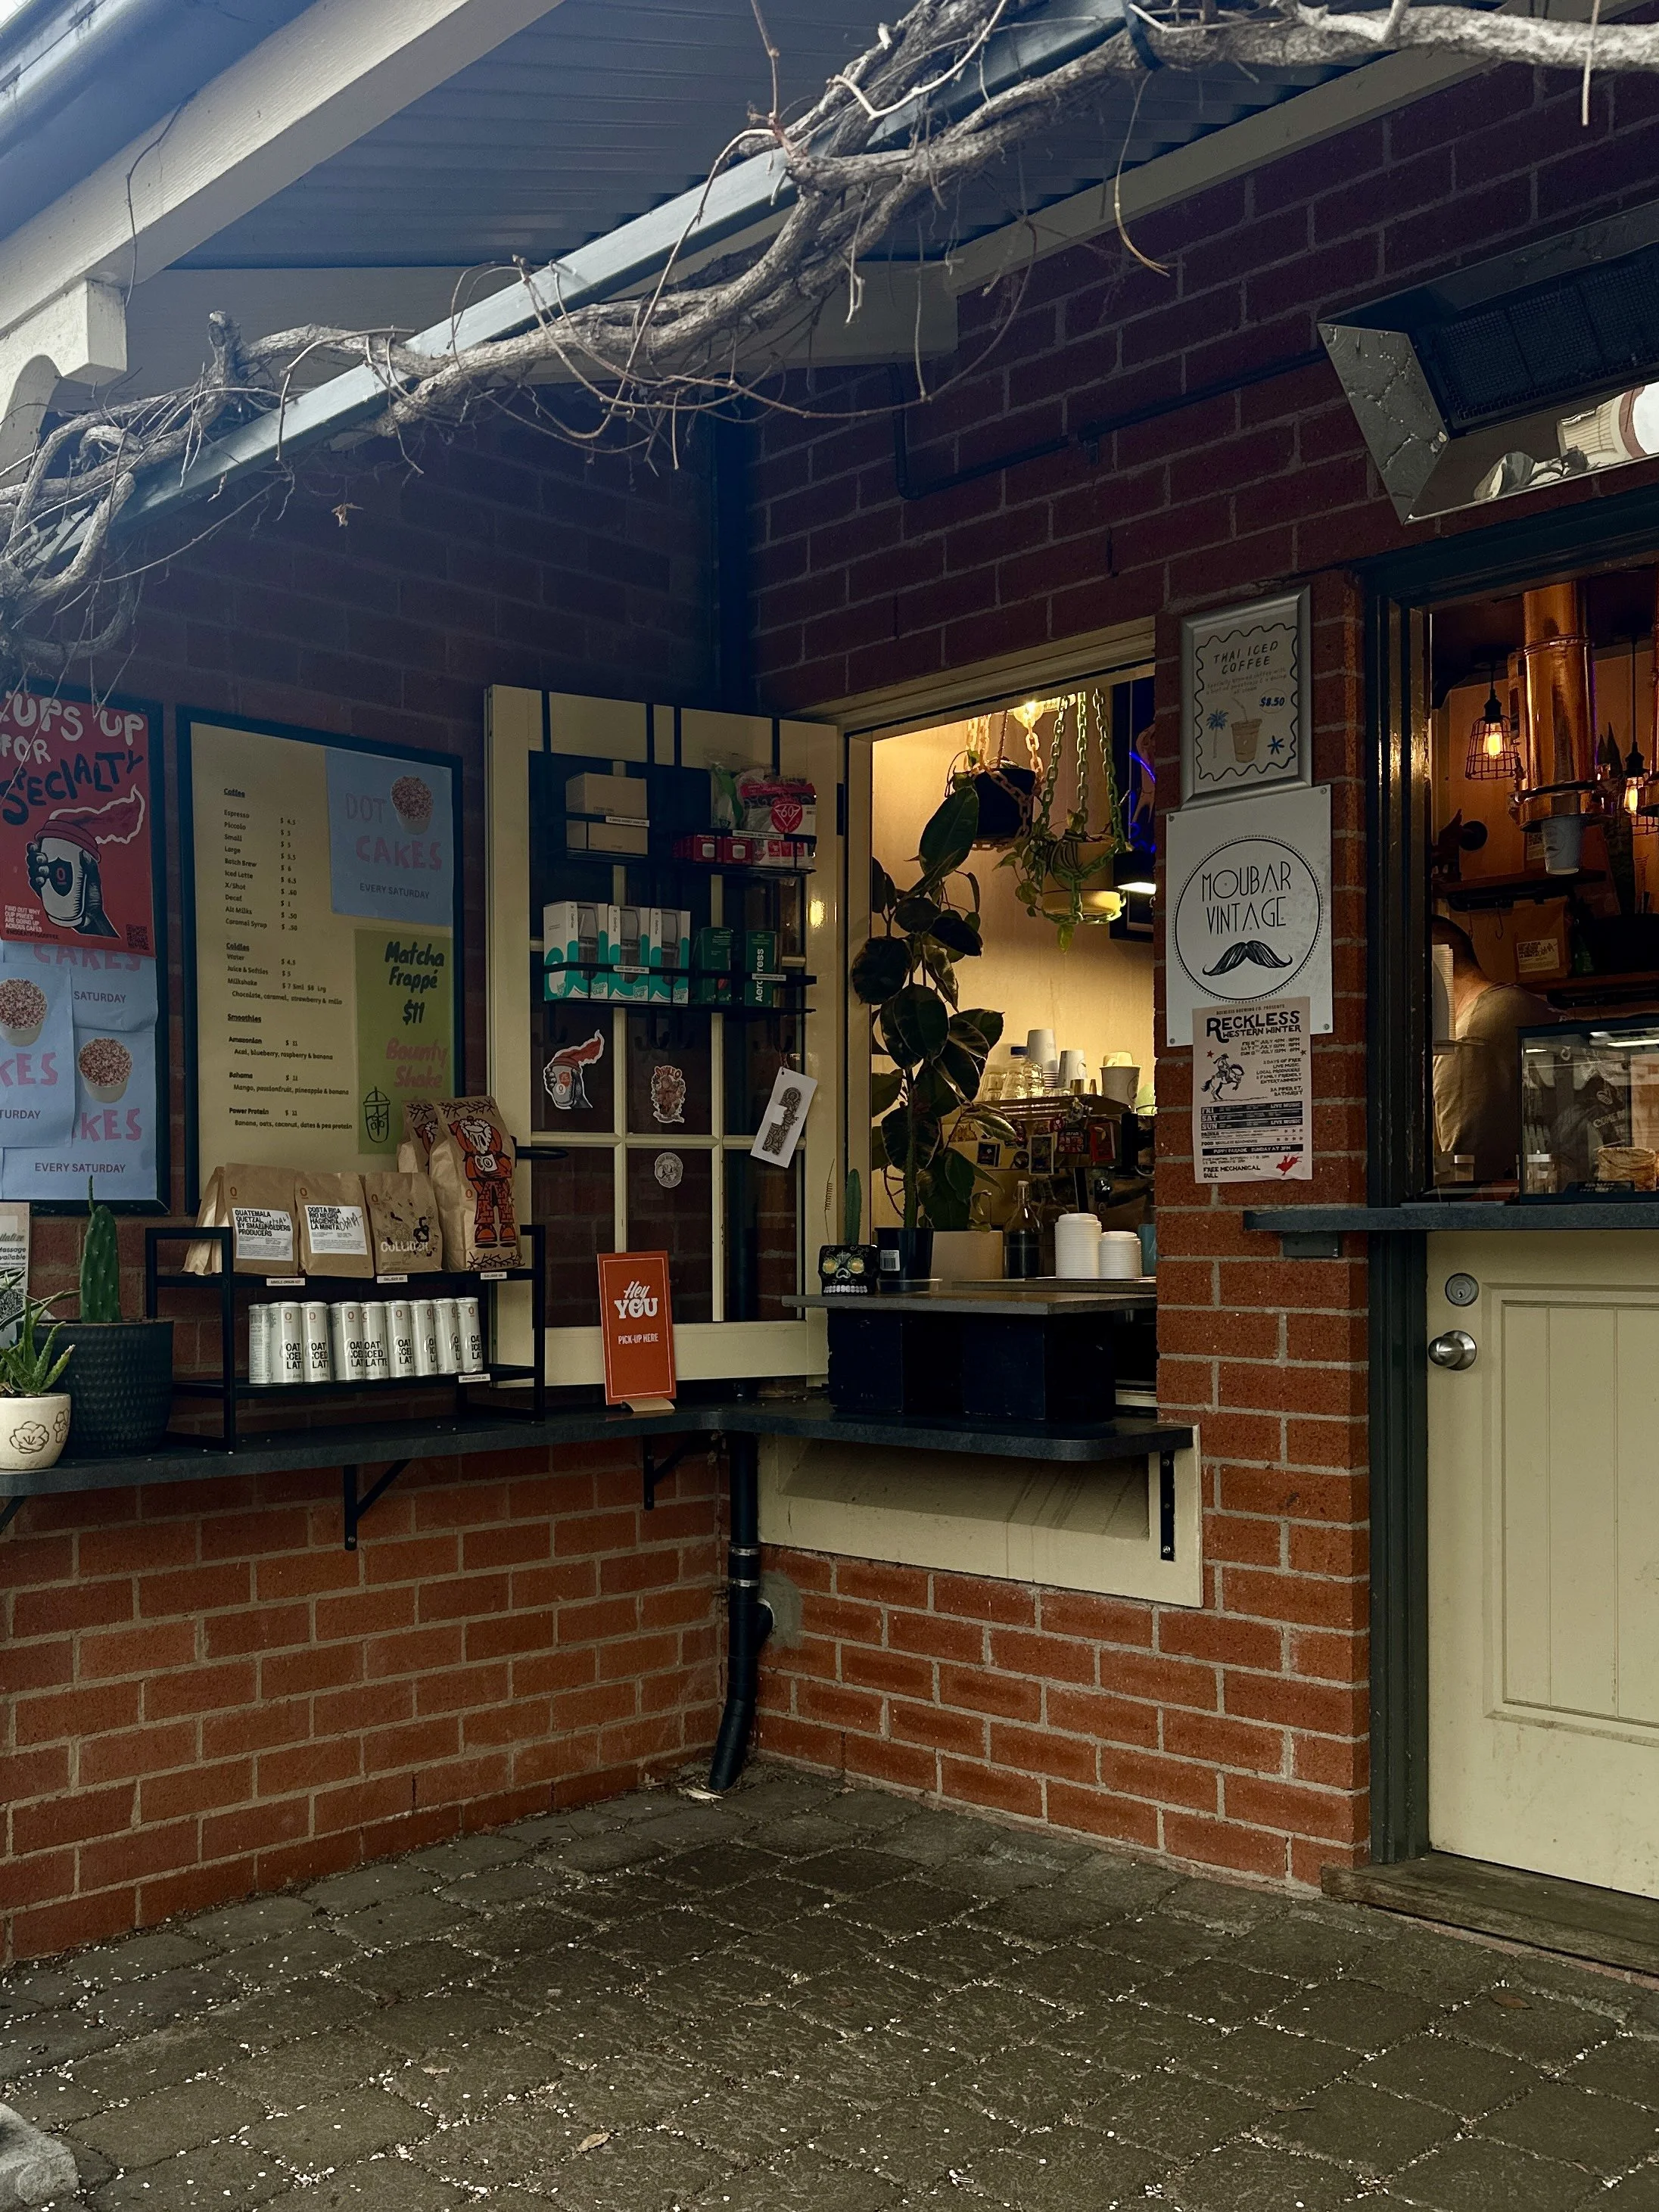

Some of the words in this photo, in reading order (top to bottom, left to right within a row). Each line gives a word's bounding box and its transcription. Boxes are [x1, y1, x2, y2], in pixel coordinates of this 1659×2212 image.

[1213, 649, 1241, 664] THAI
[1248, 641, 1278, 655] ICED
[1222, 655, 1271, 674] COFFEE
[100, 711, 144, 745] UP
[0, 734, 51, 764] FOR
[224, 788, 245, 798] Coffee
[224, 810, 250, 818] Espresso
[346, 793, 386, 823] DOT
[224, 822, 246, 830] Piccolo
[225, 846, 241, 854] Large
[356, 835, 442, 871] CAKES
[1202, 861, 1291, 902] MOUBAR
[360, 883, 386, 893] EVERY
[388, 887, 430, 899] SATURDAY
[226, 918, 250, 926] Caramel
[251, 921, 267, 929] Syrup
[1206, 896, 1286, 935] VINTAGE
[226, 943, 249, 951] Coldies
[384, 941, 444, 967] Matcha
[228, 978, 257, 986] Milkshake
[389, 966, 437, 993] Frappé
[755, 948, 764, 1002] Aeroress
[74, 991, 126, 1003] SATURDAY
[291, 996, 321, 1004] strawberry
[228, 1014, 261, 1023] Smoothies
[403, 1000, 425, 1025] $11
[1206, 1011, 1300, 1043] RECKLESS
[1223, 1028, 1263, 1038] WESTERN
[1266, 1025, 1301, 1034] WINTER
[251, 1050, 279, 1058] blueberry,
[386, 1037, 447, 1068] Bounty
[394, 1066, 443, 1088] Shake
[295, 1087, 322, 1095] pineapple
[0, 1110, 40, 1119] TURDAY
[73, 1108, 142, 1141] KES
[35, 1162, 70, 1171] EVERY
[72, 1163, 126, 1173] SATURDAY
[624, 1280, 650, 1303] Hey
[615, 1298, 658, 1319] YOU
[365, 1341, 381, 1349] OAT
[643, 1333, 659, 1342] HERE
[312, 1342, 326, 1351] OAT
